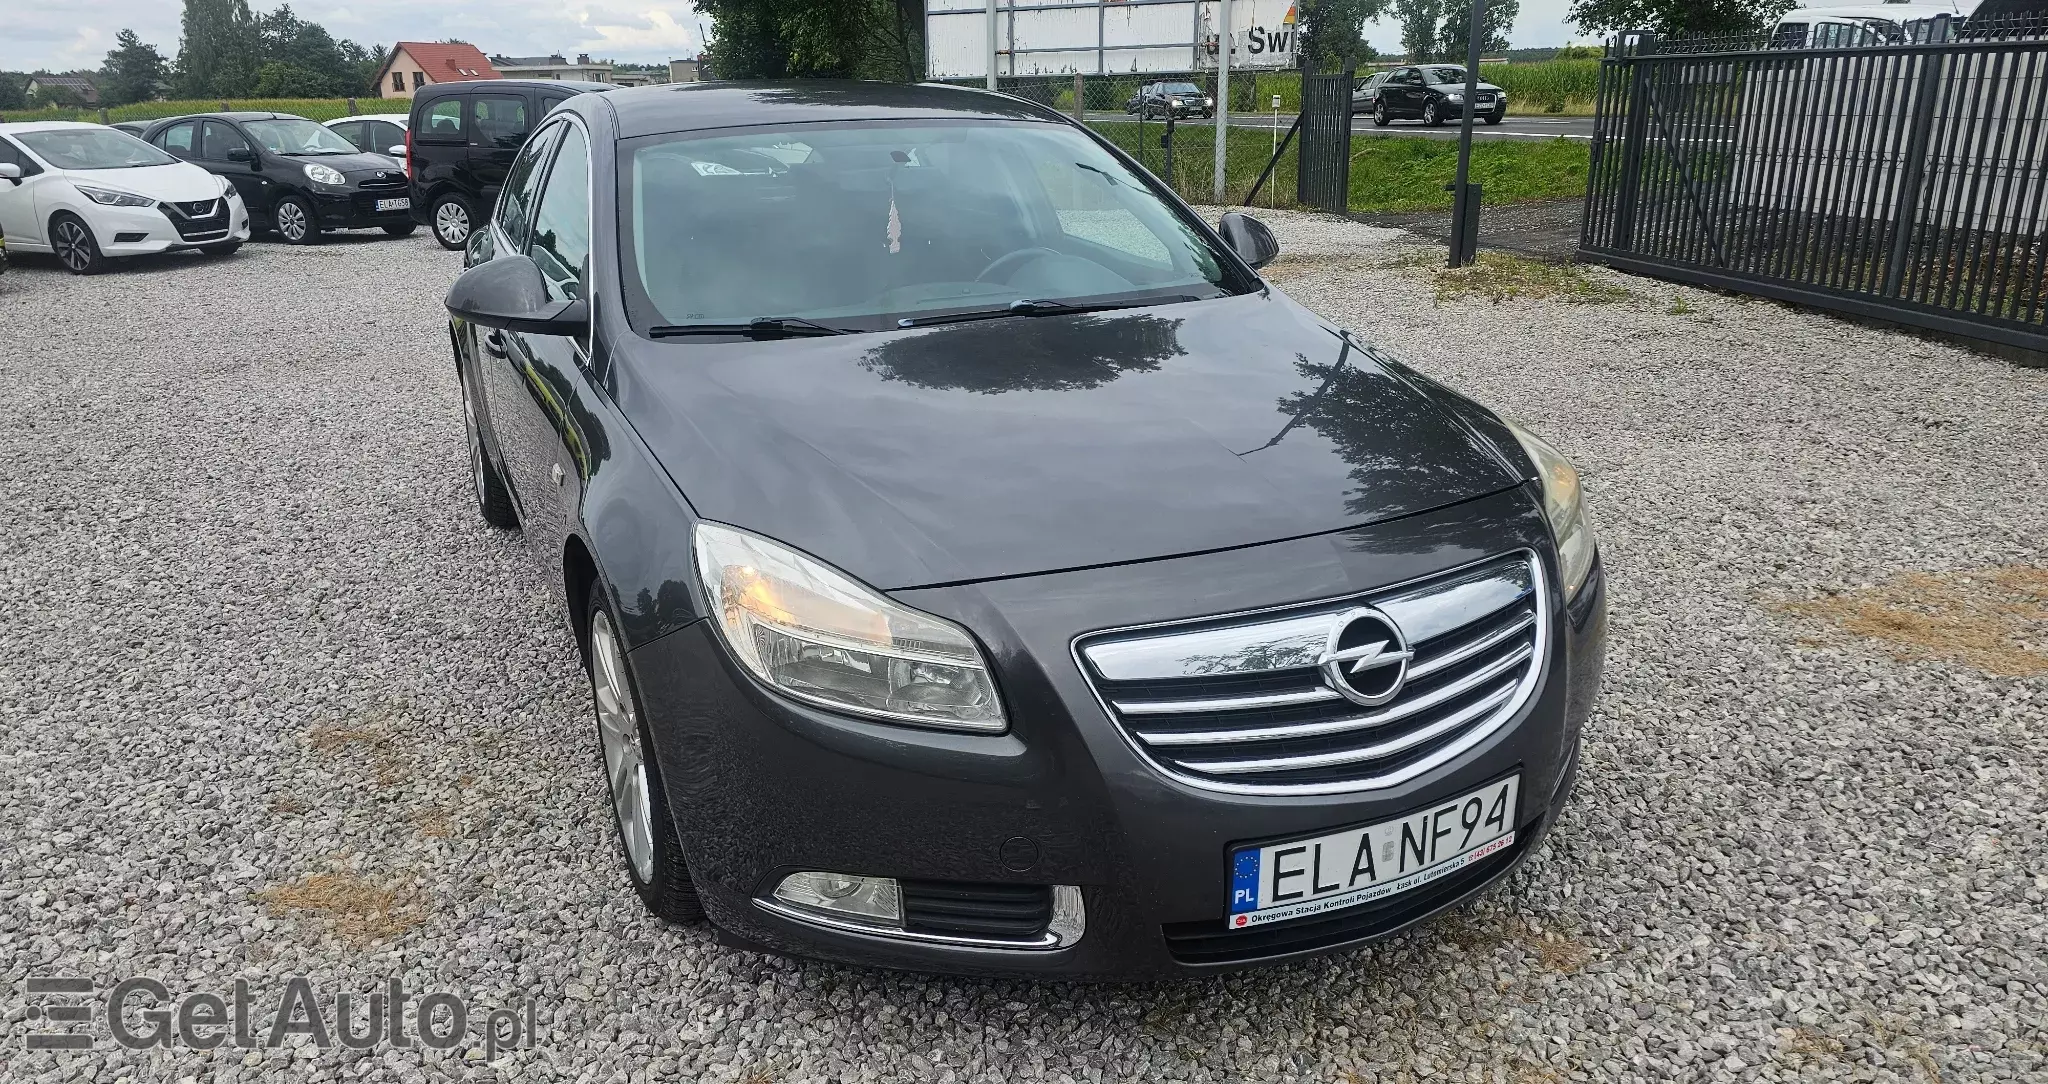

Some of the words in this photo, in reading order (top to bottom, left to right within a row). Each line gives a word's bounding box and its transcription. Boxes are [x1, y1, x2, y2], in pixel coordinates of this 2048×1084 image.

[1272, 832, 1377, 903] ELA
[1399, 783, 1509, 874] NF94
[1234, 887, 1255, 905] PL
[1251, 909, 1293, 923] Okręgowa
[1295, 903, 1321, 915] Stacja
[1323, 896, 1355, 910] Kontroli
[1356, 887, 1392, 902] Pojazdów
[1396, 879, 1412, 891] Łask
